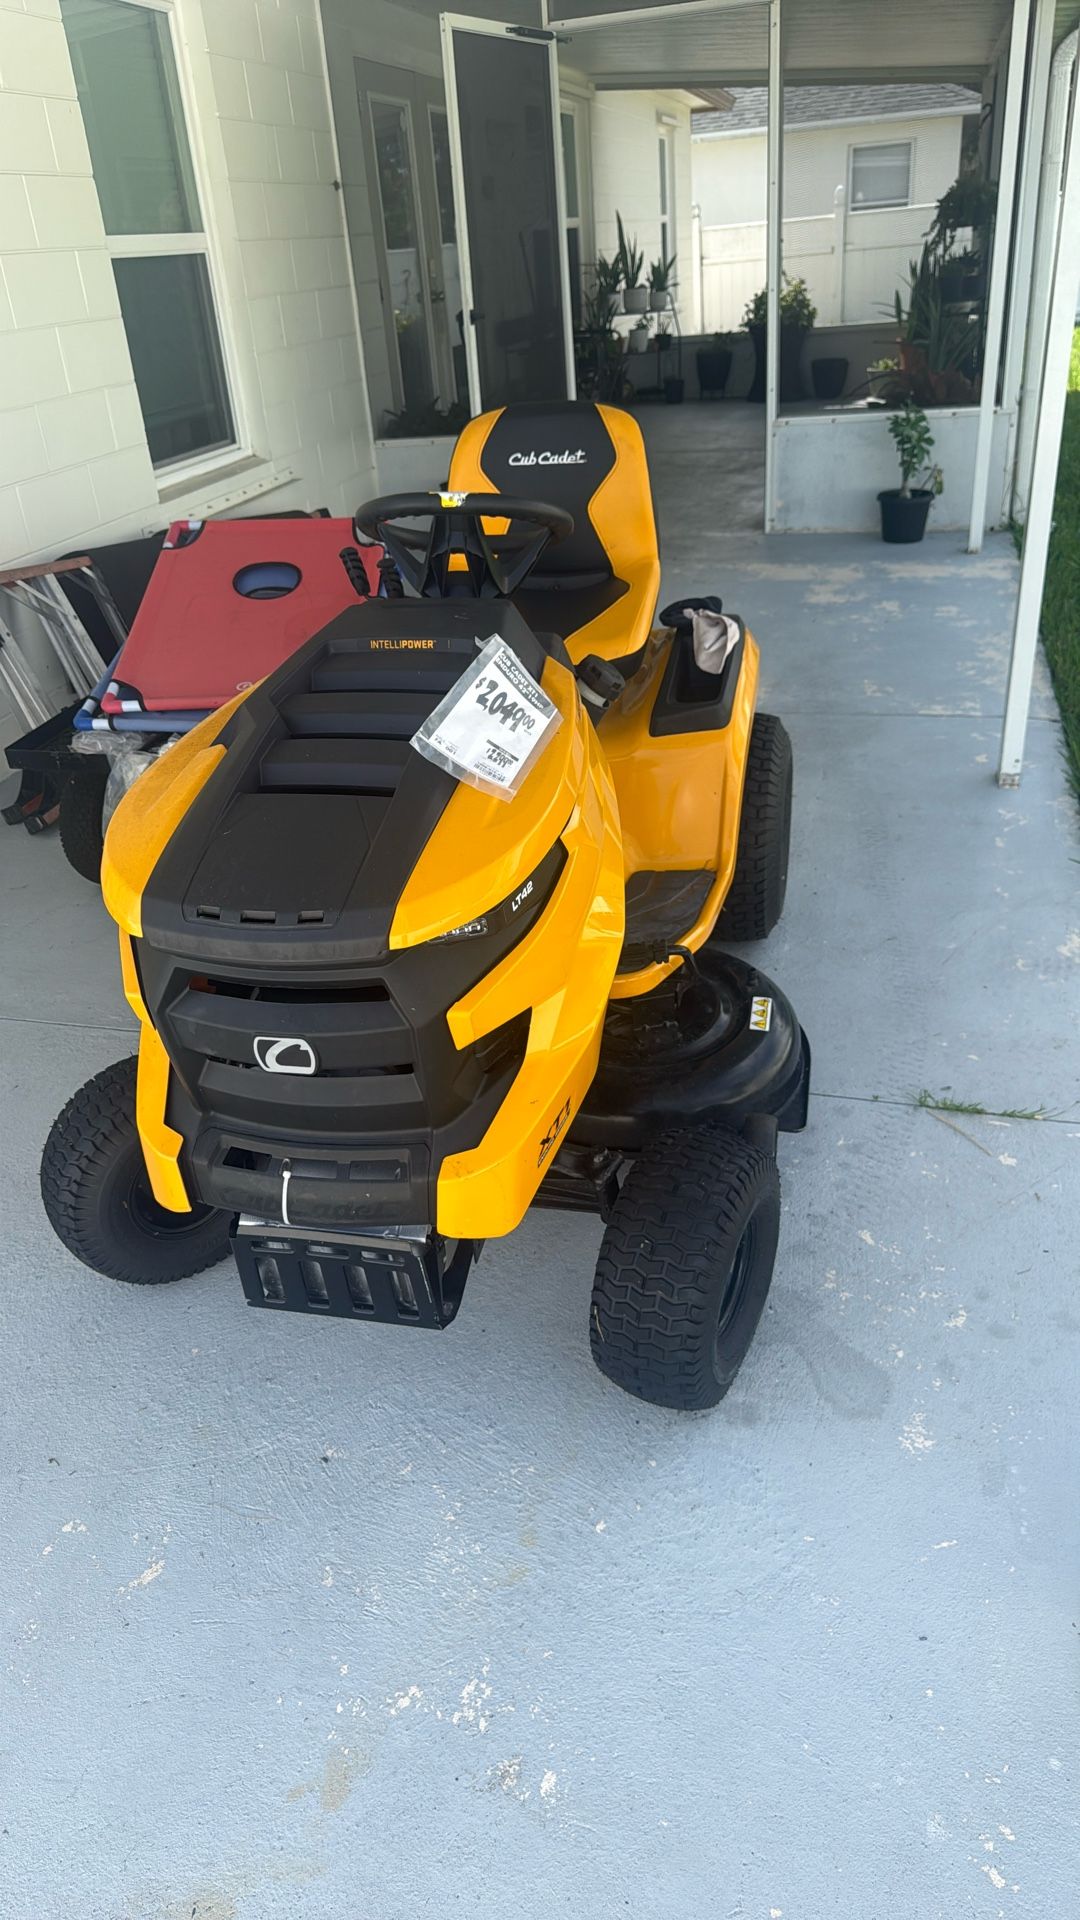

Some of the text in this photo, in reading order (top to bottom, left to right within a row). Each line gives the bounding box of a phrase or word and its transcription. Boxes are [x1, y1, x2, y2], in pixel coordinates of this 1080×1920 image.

[508, 449, 587, 466] Cub Cadet
[495, 657, 519, 685] ENDURO
[500, 653, 512, 667] CUB
[511, 666, 529, 686] CADET
[511, 880, 534, 912] LT42
